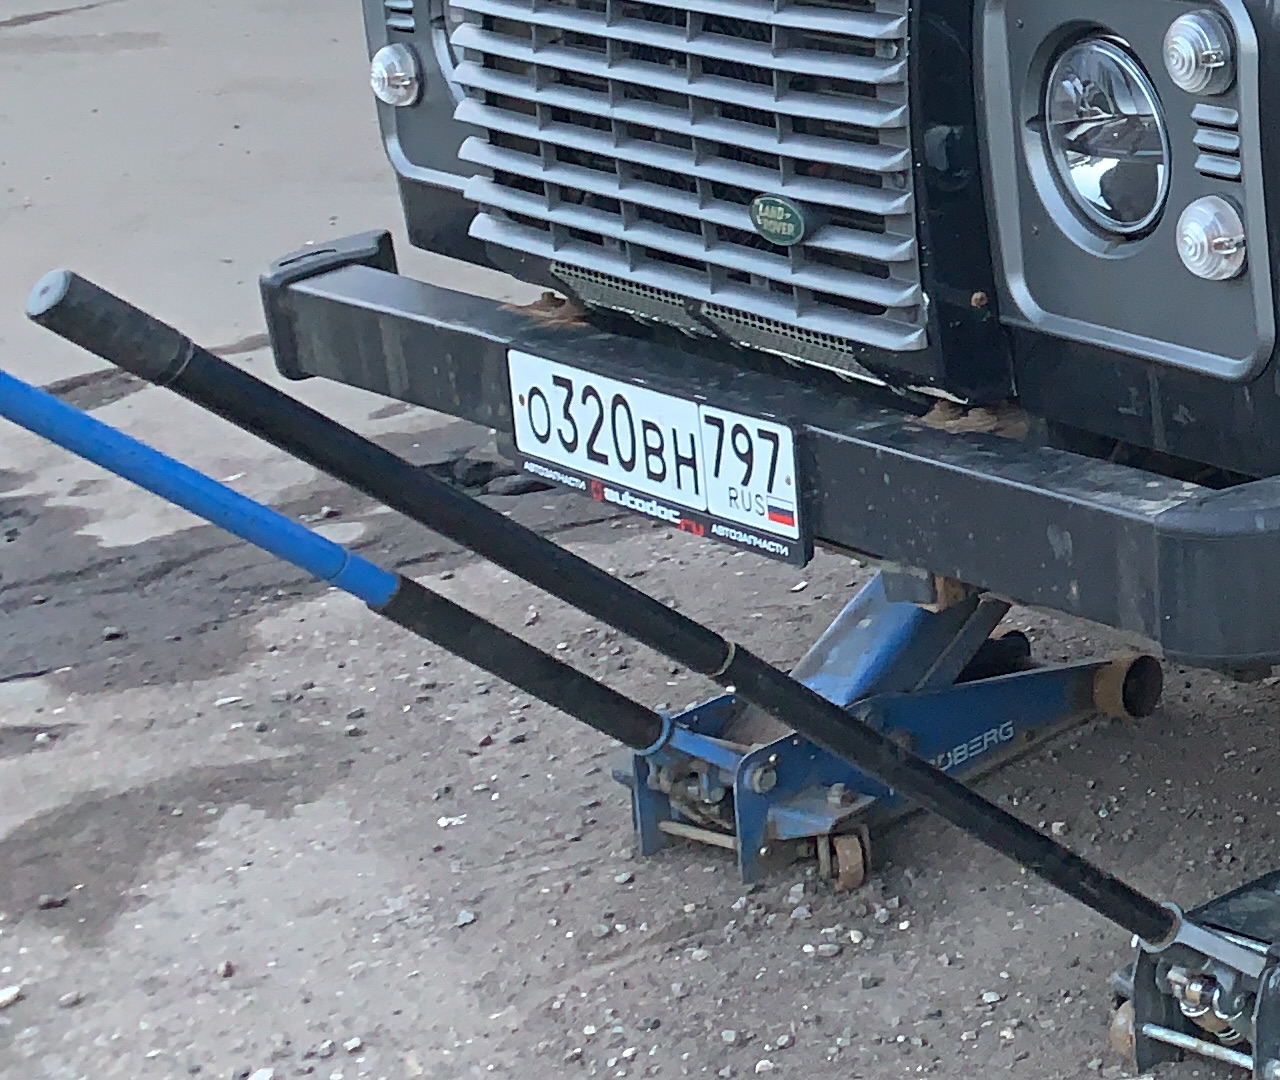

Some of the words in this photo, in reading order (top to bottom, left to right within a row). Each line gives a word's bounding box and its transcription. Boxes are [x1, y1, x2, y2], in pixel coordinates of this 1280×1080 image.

[758, 203, 785, 220] LAND
[762, 219, 795, 236] ROVER
[704, 415, 780, 494] 797
[728, 486, 766, 518] RUS
[711, 523, 789, 557] АВТОЗАПЧАСТИ
[928, 720, 1015, 772] DBERG
